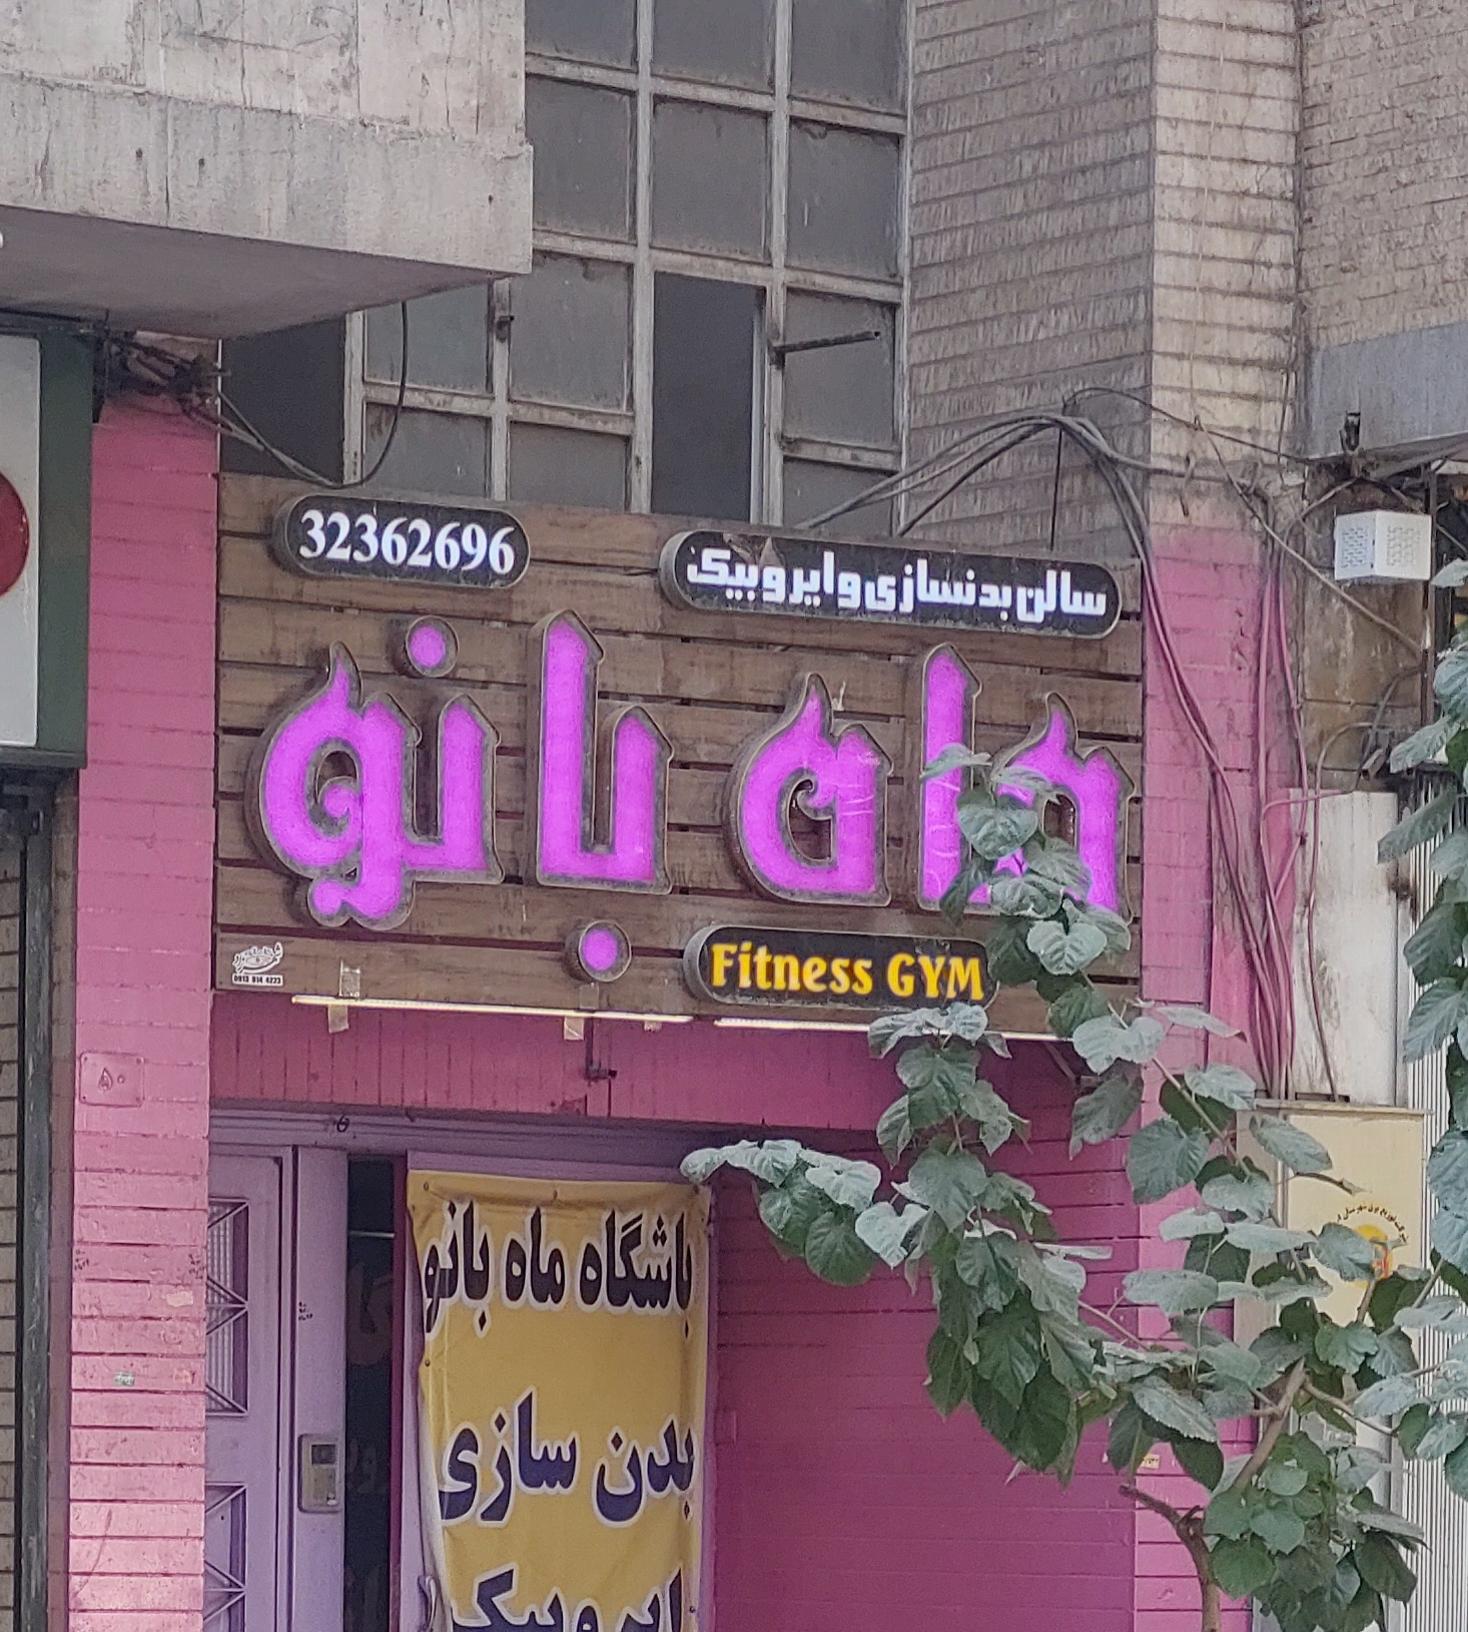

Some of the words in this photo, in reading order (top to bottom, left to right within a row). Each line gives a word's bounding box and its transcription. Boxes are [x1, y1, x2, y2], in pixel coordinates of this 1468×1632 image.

[300, 509, 516, 576] 32362696
[1016, 569, 1107, 624] سالن
[256, 612, 660, 976] بانو
[736, 648, 1128, 918] ماه
[711, 941, 874, 995] Fitness
[886, 953, 986, 1001] GYM
[423, 1203, 490, 1334] بانو
[505, 1206, 566, 1304] ماه
[580, 1209, 694, 1338] باشگاه
[440, 1392, 577, 1521] سازی
[596, 1420, 694, 1521] بدن
